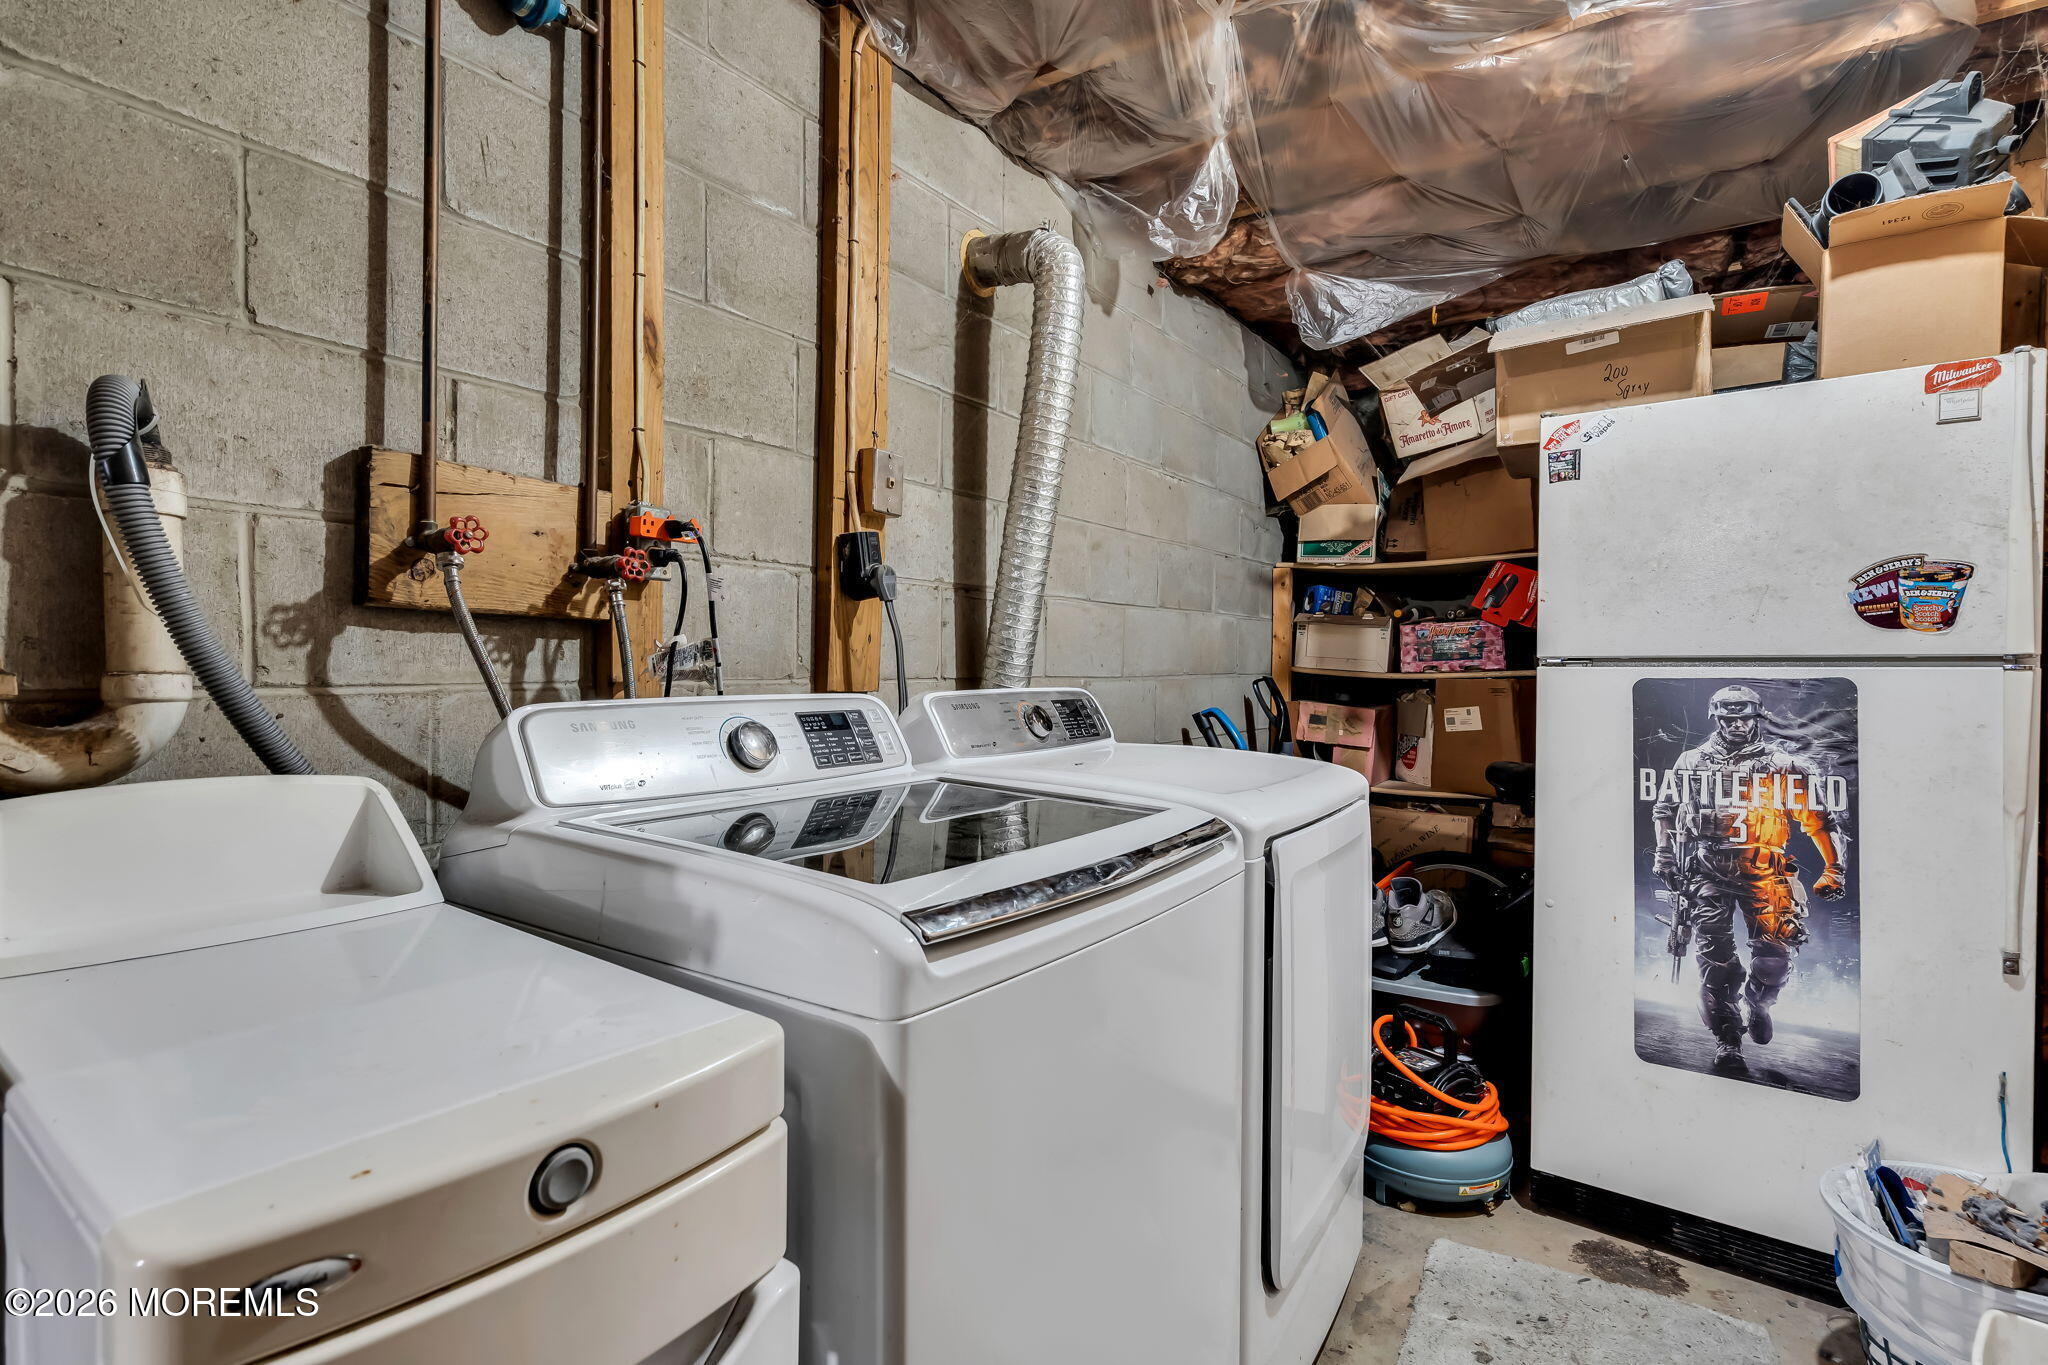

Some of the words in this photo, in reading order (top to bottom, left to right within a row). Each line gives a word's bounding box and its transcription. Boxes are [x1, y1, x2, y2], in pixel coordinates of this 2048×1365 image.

[1603, 363, 1629, 382] 200
[1931, 361, 1994, 385] Milwaukee
[1399, 430, 1436, 449] Amaretto
[1441, 419, 1472, 436] Amore
[1595, 419, 1616, 438] vapes
[1847, 580, 1898, 605] NEW!
[1912, 604, 1943, 613] Scotchy
[951, 702, 981, 711] SAMSUNG
[1639, 768, 1849, 812] BATTLEFIELD
[1419, 824, 1441, 842] WINE
[1728, 808, 1749, 843] 3
